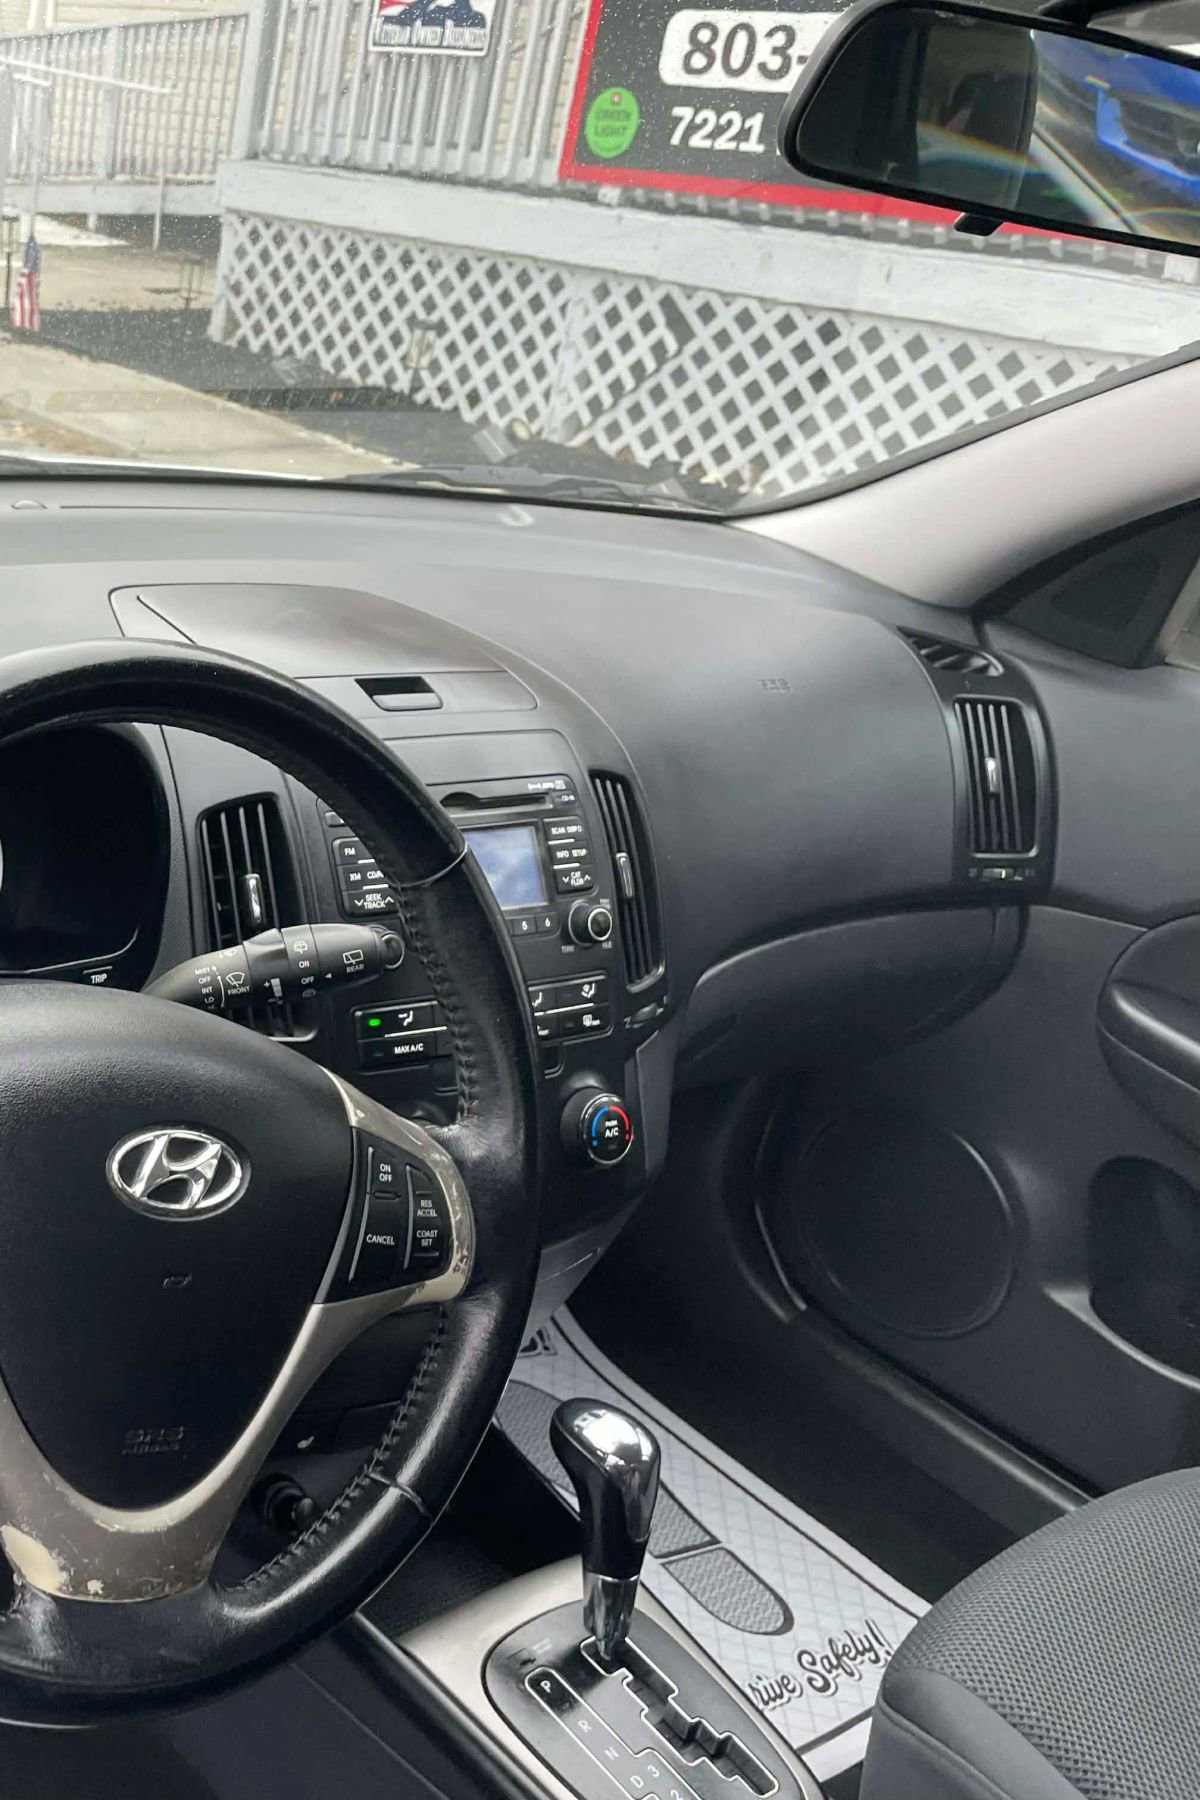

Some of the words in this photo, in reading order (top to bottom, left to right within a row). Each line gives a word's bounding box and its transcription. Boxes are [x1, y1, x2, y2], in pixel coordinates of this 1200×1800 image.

[670, 106, 765, 153] 7221
[344, 847, 356, 856] FM
[349, 872, 361, 882] XM
[363, 901, 386, 909] TRACK
[298, 960, 310, 969] ON
[346, 963, 365, 974] REAR
[90, 973, 107, 984] TRIP
[198, 976, 211, 985] OFF
[301, 975, 315, 985] OFF
[201, 986, 213, 995] INT
[227, 985, 251, 996] FRONT
[204, 996, 215, 1004] LO
[604, 1127, 619, 1139] A/C
[379, 1163, 392, 1173] ON
[379, 1173, 393, 1183] OFF
[420, 1199, 433, 1208] RES
[416, 1208, 438, 1217] ACCEL
[416, 1229, 438, 1239] COAST
[366, 1233, 395, 1246] CANCEL
[420, 1238, 433, 1247] SET
[748, 1674, 796, 1706] rive
[797, 1618, 892, 1693] Safely!
[540, 1680, 551, 1694] P
[578, 1719, 593, 1733] R
[630, 1775, 644, 1788] D
[648, 1765, 660, 1778] 3
